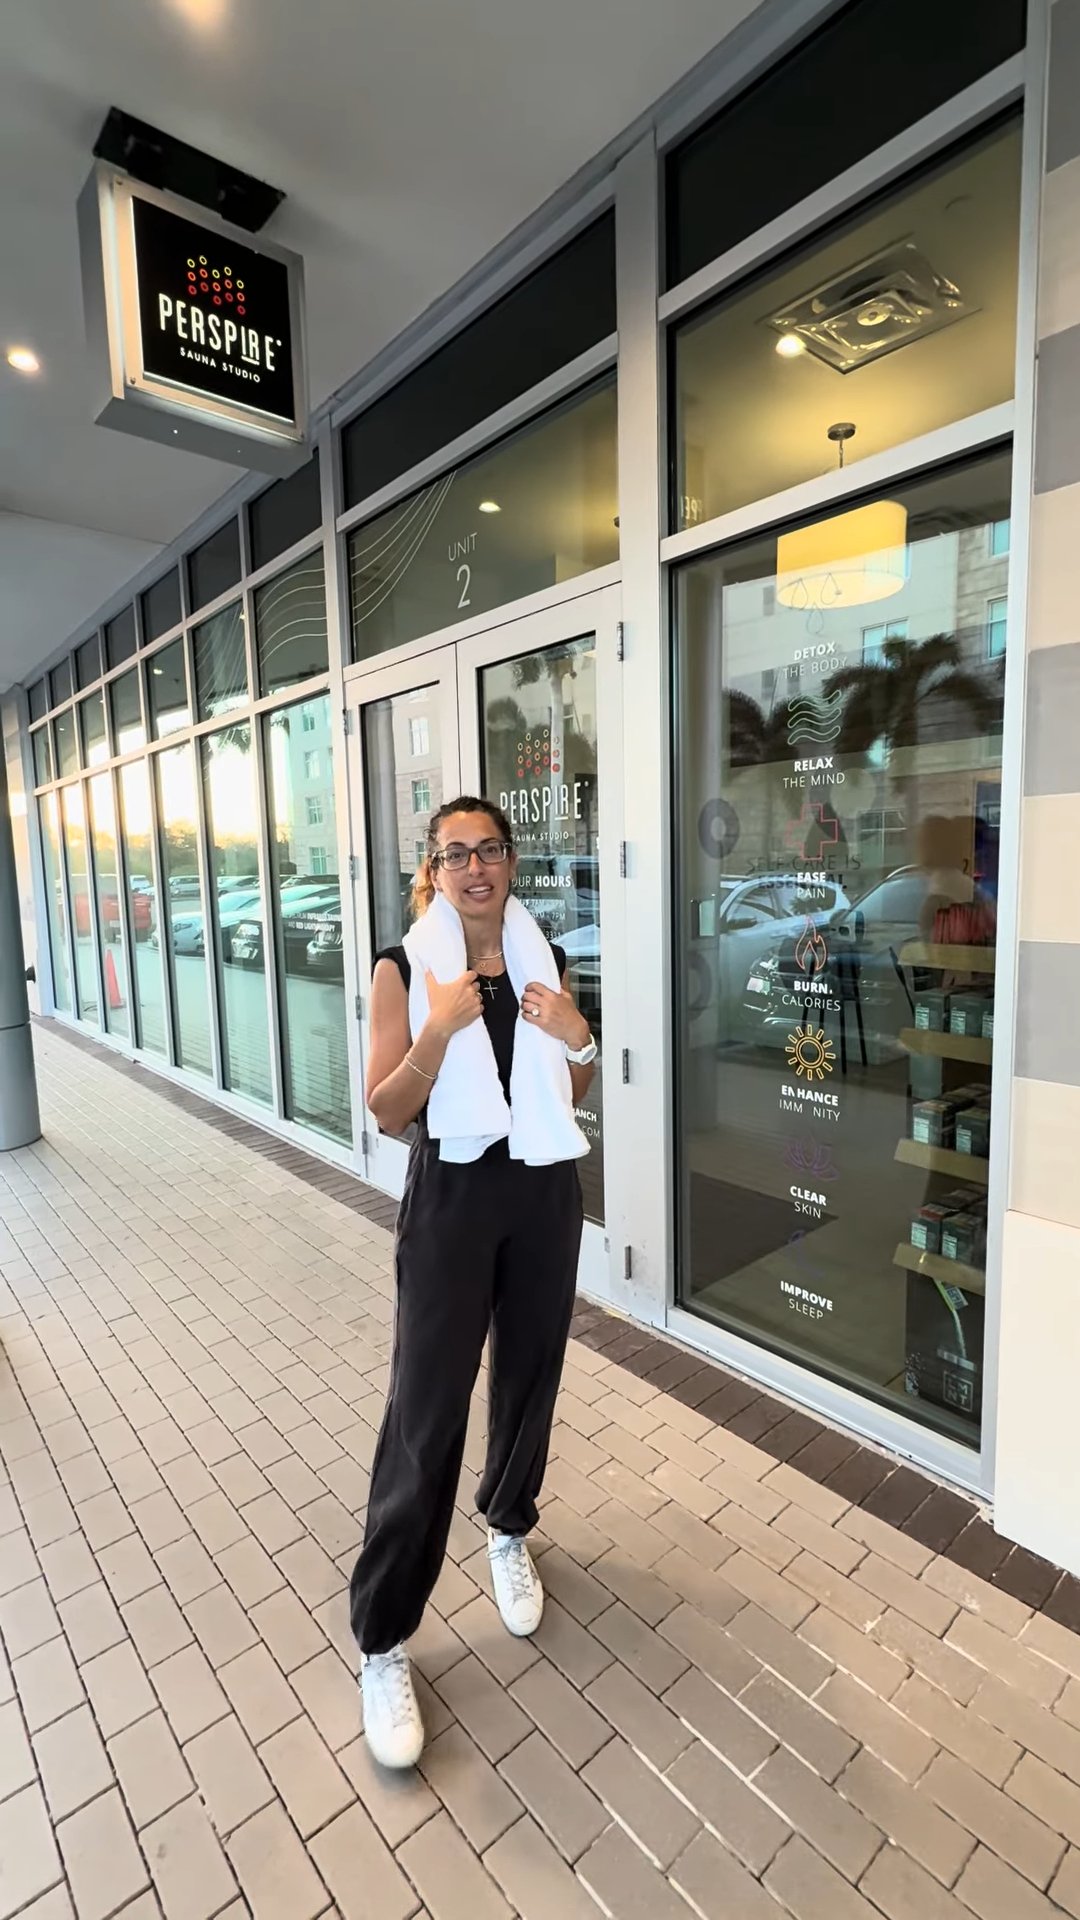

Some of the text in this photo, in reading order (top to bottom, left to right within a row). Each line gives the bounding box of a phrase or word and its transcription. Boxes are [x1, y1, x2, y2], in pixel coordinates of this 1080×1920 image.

[159, 293, 276, 372] PERSPIRE
[180, 347, 260, 383] SAUNA STUDIO
[448, 531, 478, 561] UNIT
[456, 564, 471, 609] 2
[794, 641, 836, 661] DETOX
[783, 656, 847, 679] THE BODY
[794, 757, 834, 772] RELAX
[783, 772, 845, 789] THE MIND
[540, 831, 569, 841] STUDIO
[535, 875, 571, 888] HOURS
[797, 872, 826, 883] EASE
[797, 887, 826, 898] PAIN
[782, 994, 841, 1011] CALORIES
[573, 1107, 597, 1122] ANCH
[780, 1099, 840, 1121] IMMNITY
[790, 1185, 827, 1206] CLEAR
[794, 1201, 821, 1219] SKIN
[780, 1280, 833, 1311] IMPROVE
[789, 1298, 823, 1319] SLEEP
